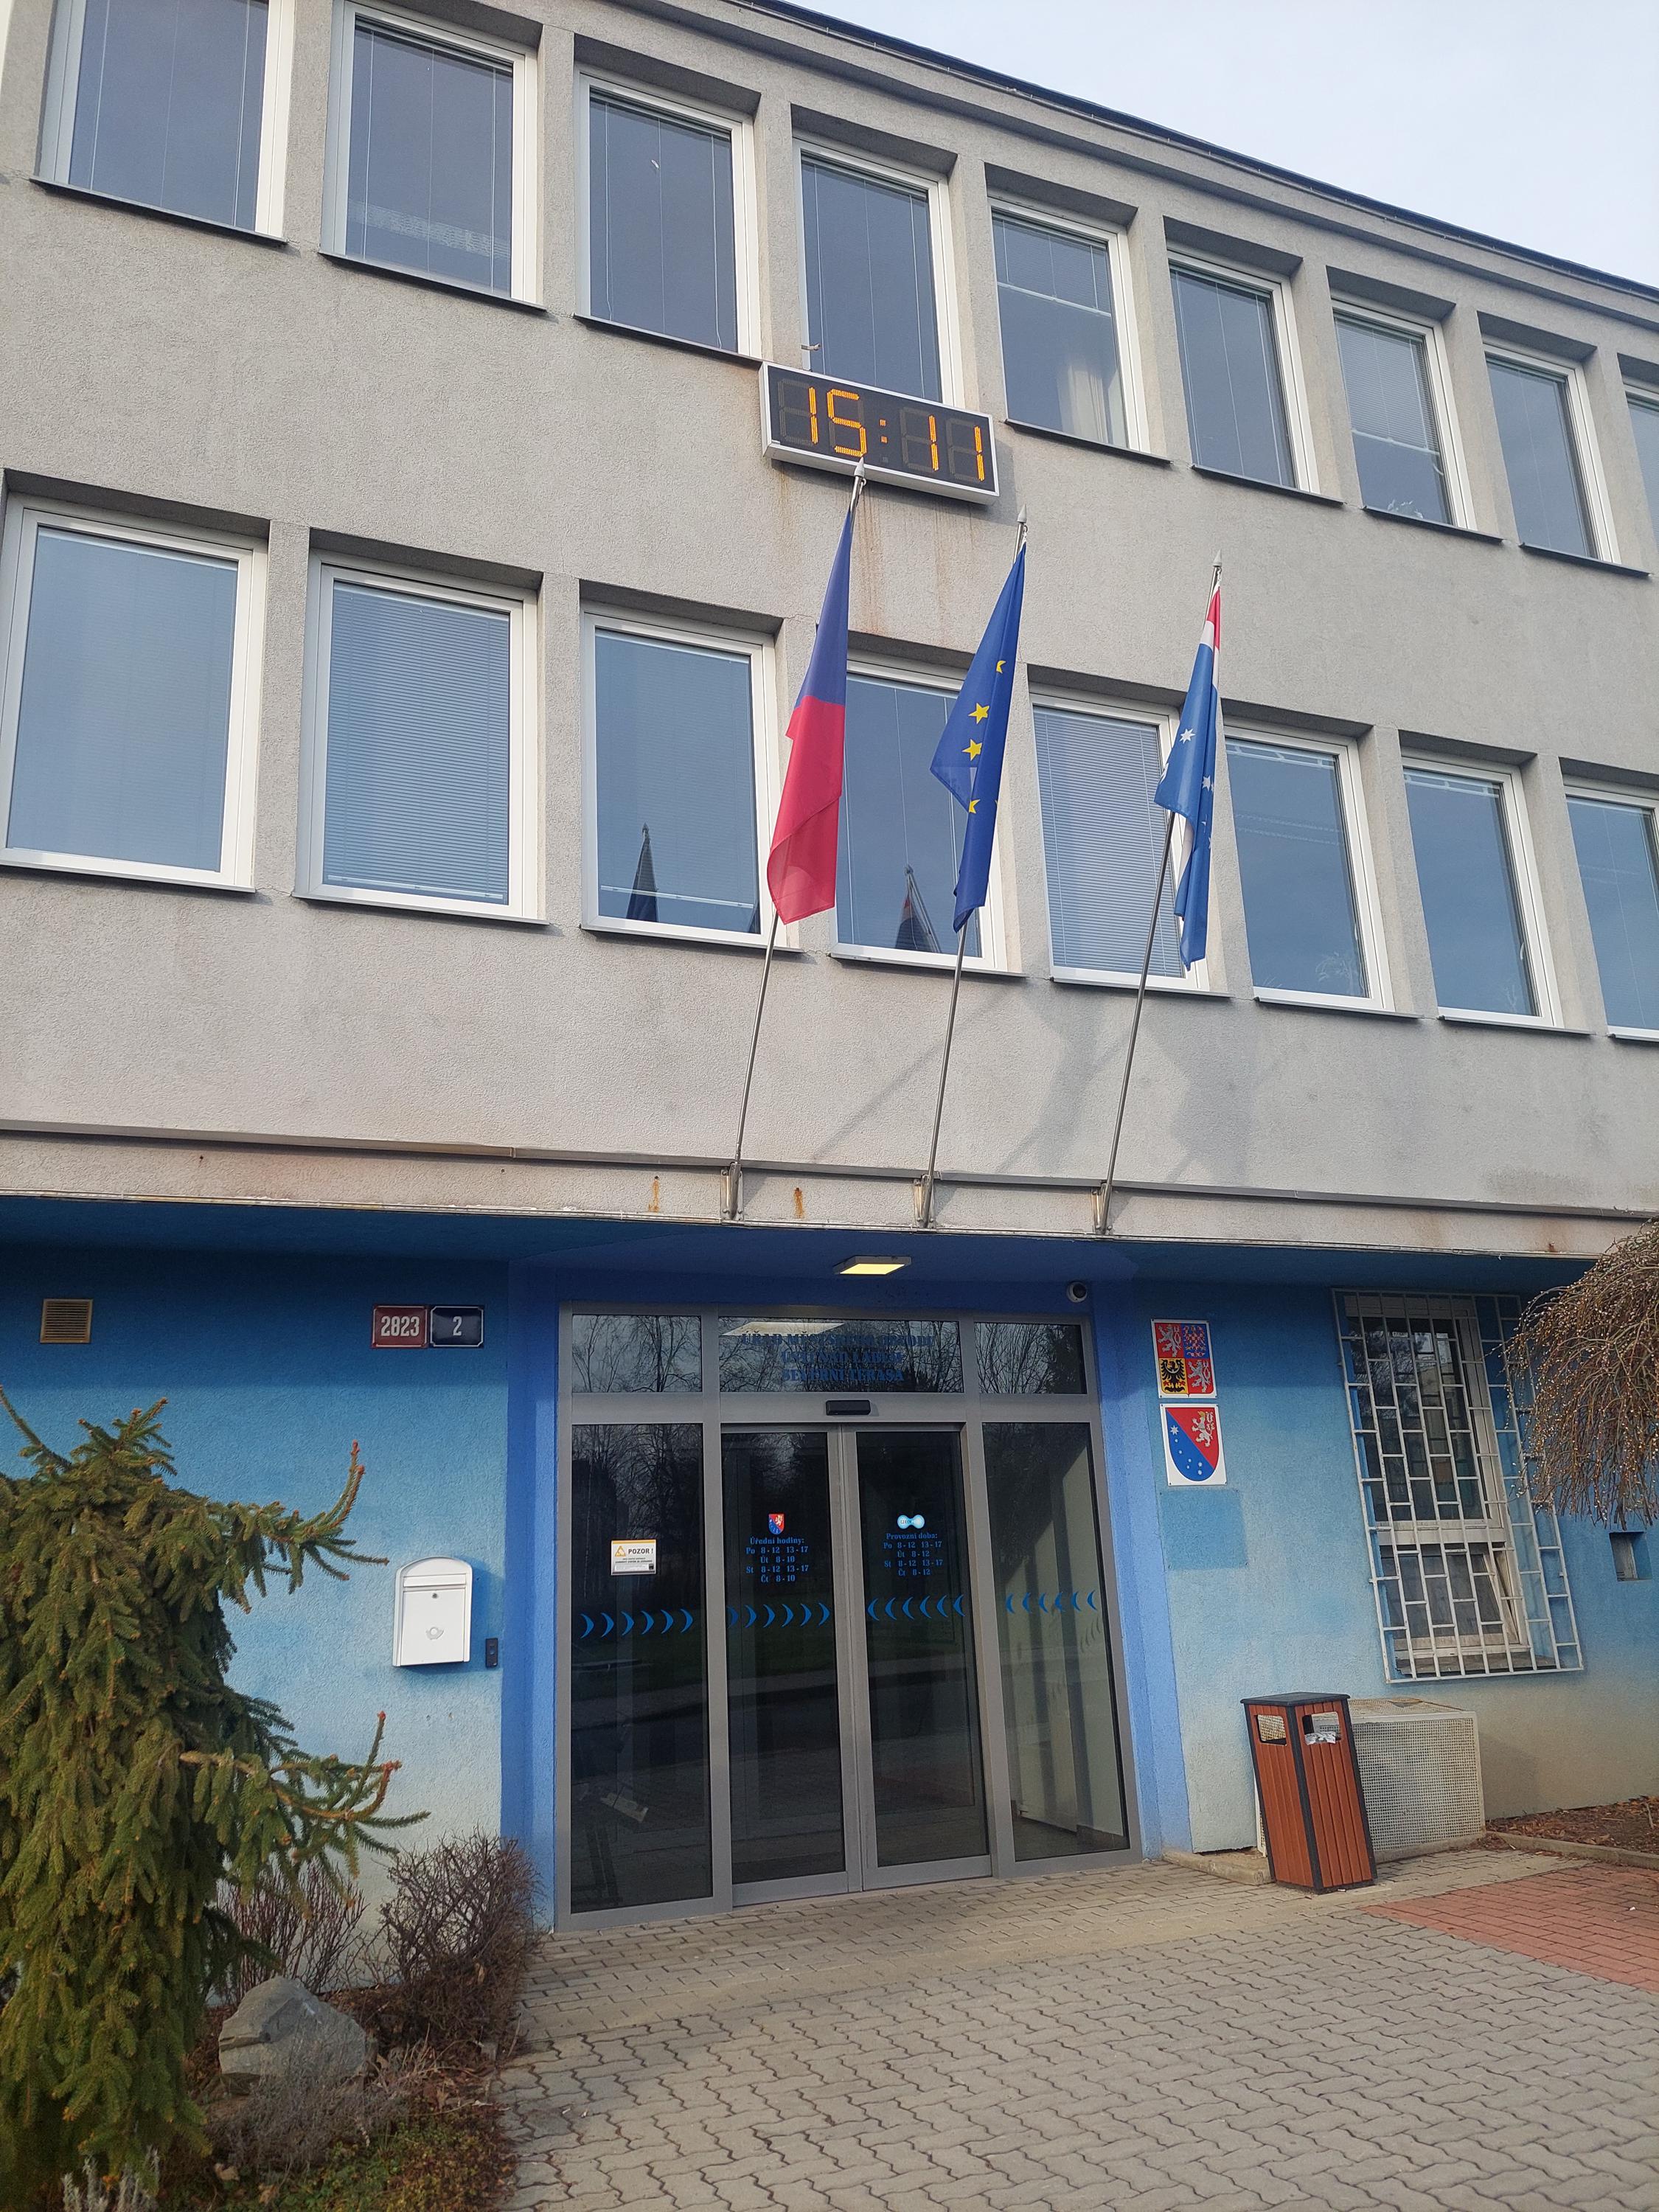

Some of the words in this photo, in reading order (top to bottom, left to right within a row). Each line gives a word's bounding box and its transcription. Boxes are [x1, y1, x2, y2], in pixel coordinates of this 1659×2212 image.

[808, 386, 985, 481] 15:11
[380, 1315, 420, 1337] 2823
[453, 1316, 462, 1336] 2
[849, 1368, 905, 1382] TERASA
[918, 1531, 938, 1540] doba:
[750, 1536, 775, 1545] Úřední
[776, 1537, 805, 1545] hodiny:
[883, 1541, 892, 1549] Po
[745, 1546, 756, 1554] Po
[760, 1554, 769, 1563] Út
[884, 1560, 891, 1568] St
[746, 1565, 754, 1573] St
[760, 1573, 770, 1583] Čt
